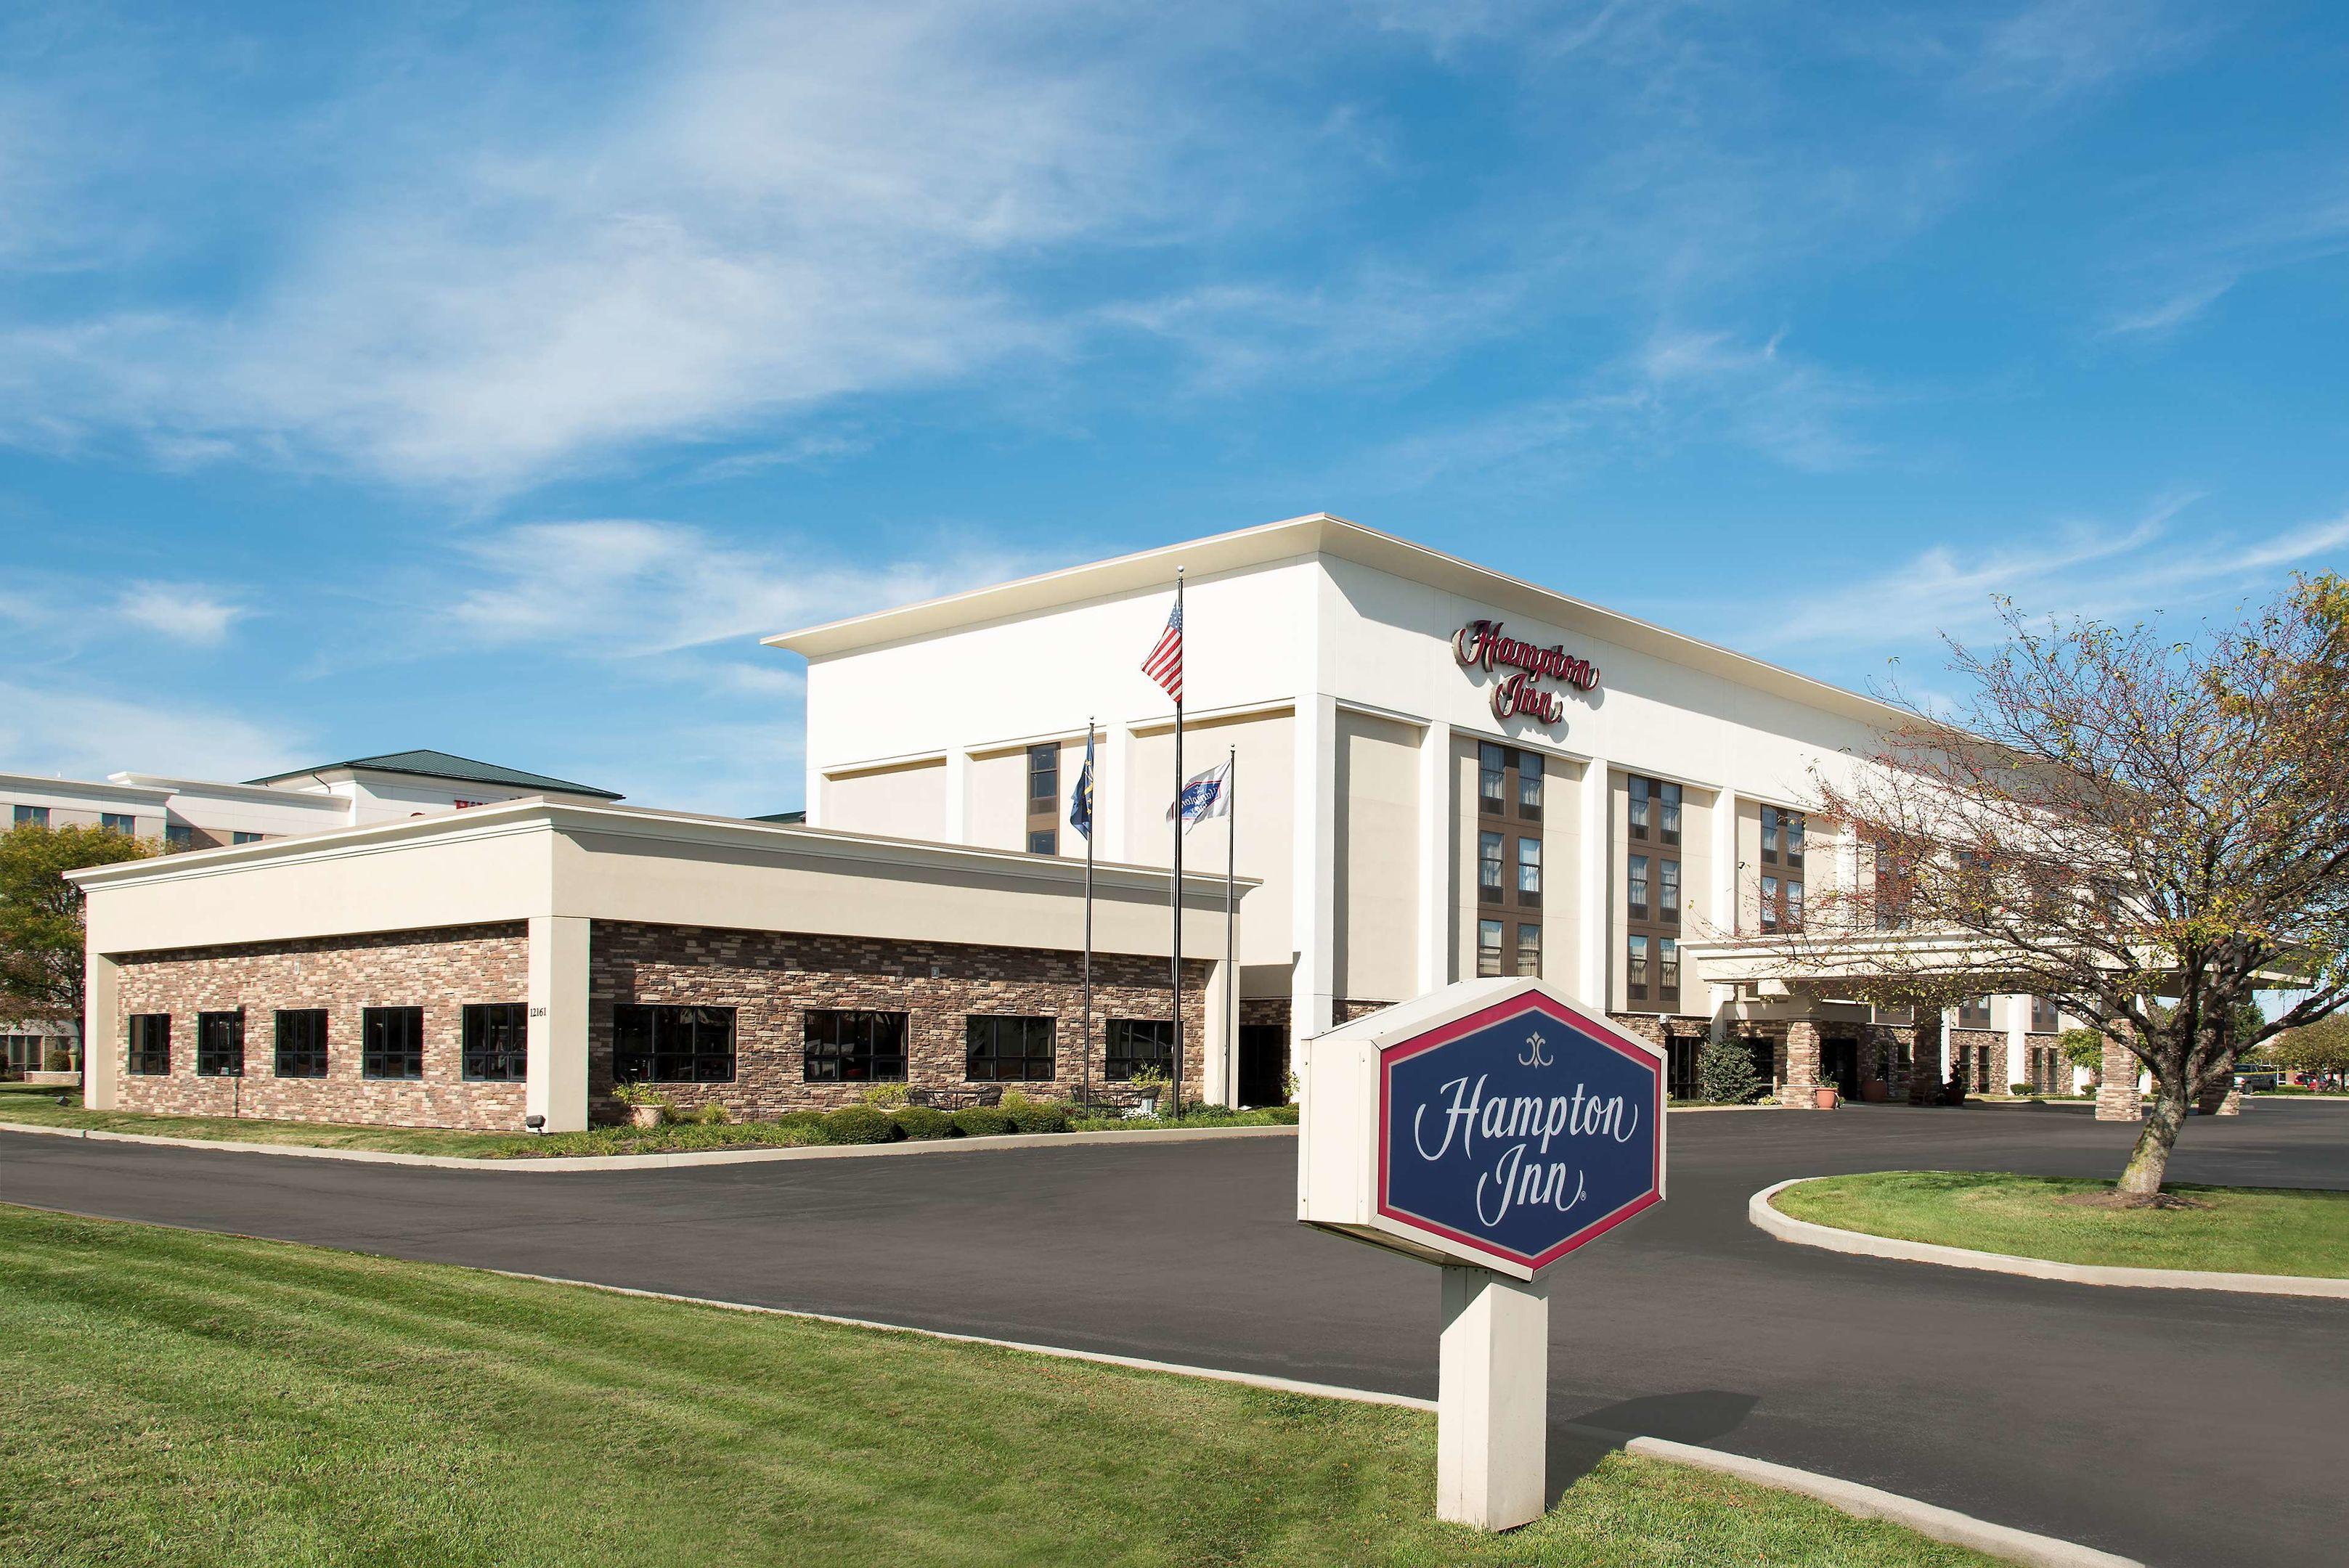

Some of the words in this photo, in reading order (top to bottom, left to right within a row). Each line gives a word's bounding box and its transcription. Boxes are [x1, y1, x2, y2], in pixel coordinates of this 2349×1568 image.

[1452, 620, 1600, 690] Hampton
[1490, 672, 1563, 724] Inn
[530, 1007, 546, 1017] 12161
[1414, 1074, 1638, 1161] Hampton
